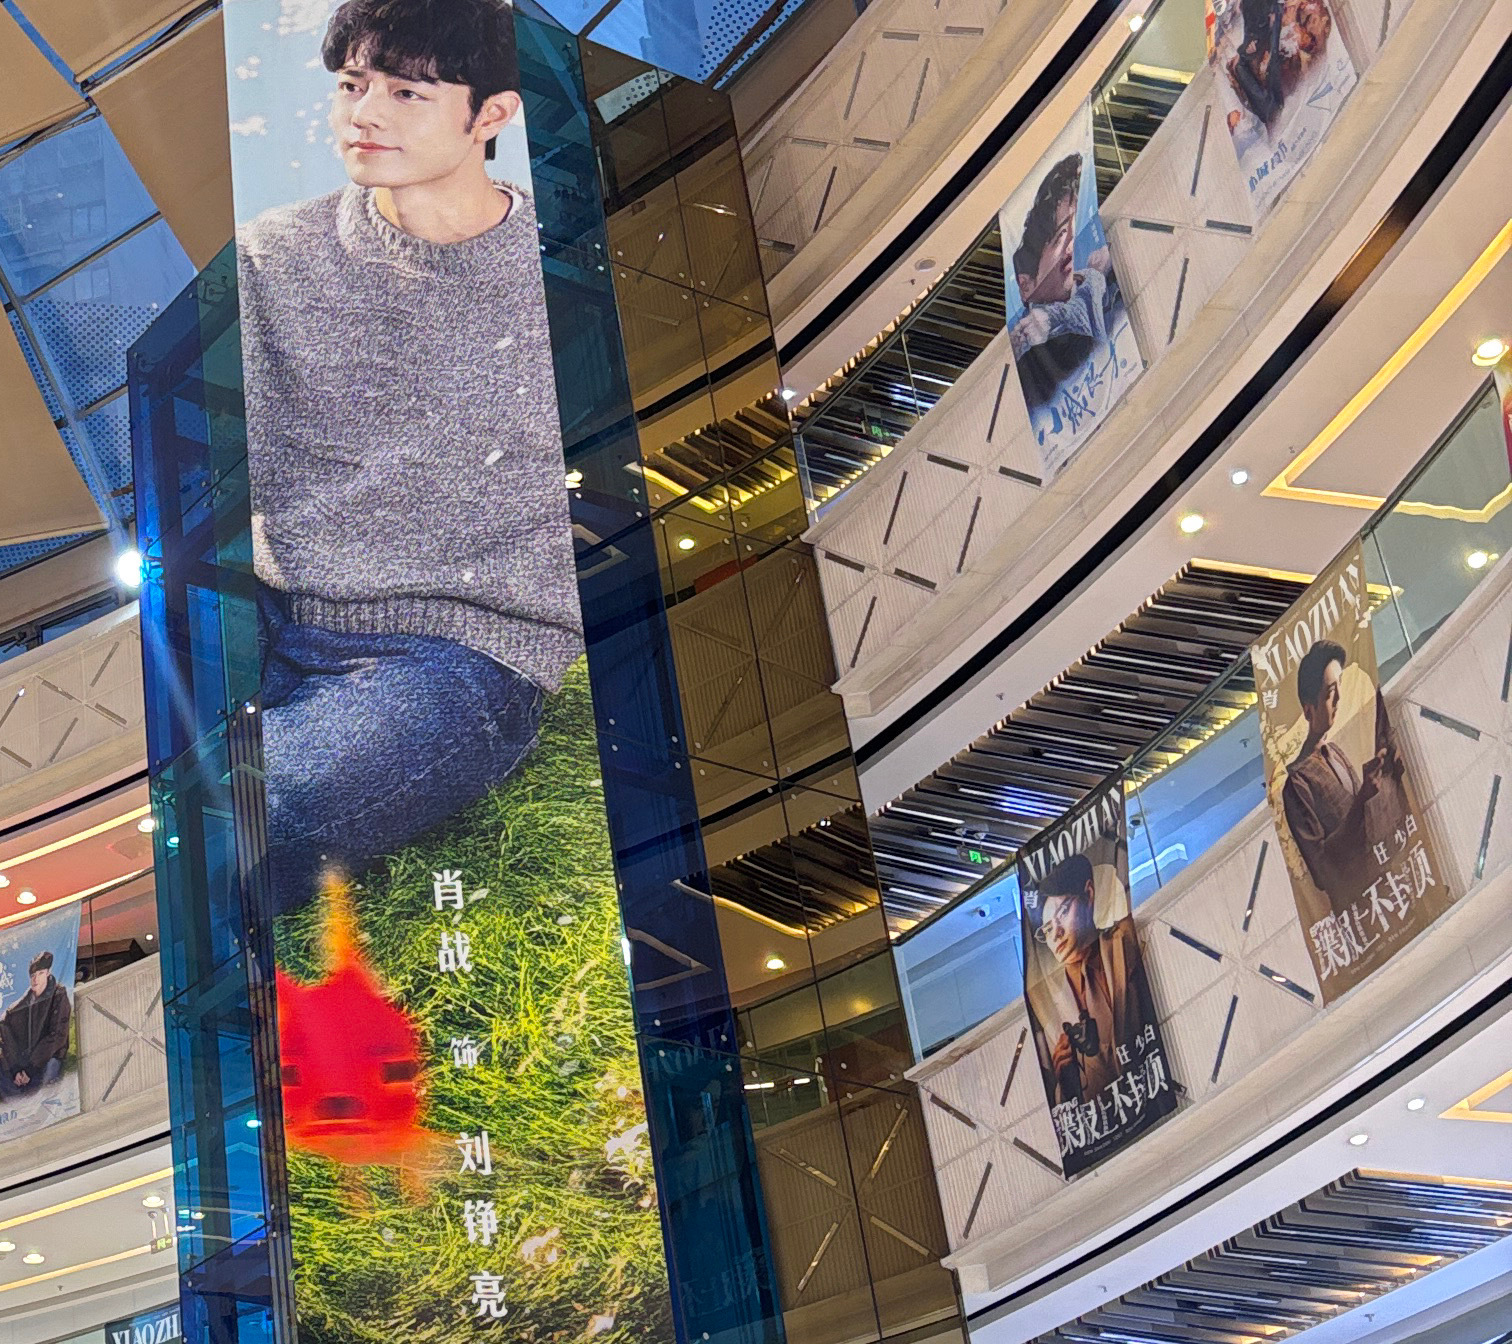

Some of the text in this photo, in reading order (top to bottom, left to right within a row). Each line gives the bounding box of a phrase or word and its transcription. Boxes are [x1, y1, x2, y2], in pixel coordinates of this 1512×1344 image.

[432, 869, 507, 1319] 肖战 饰 刘铮亮
